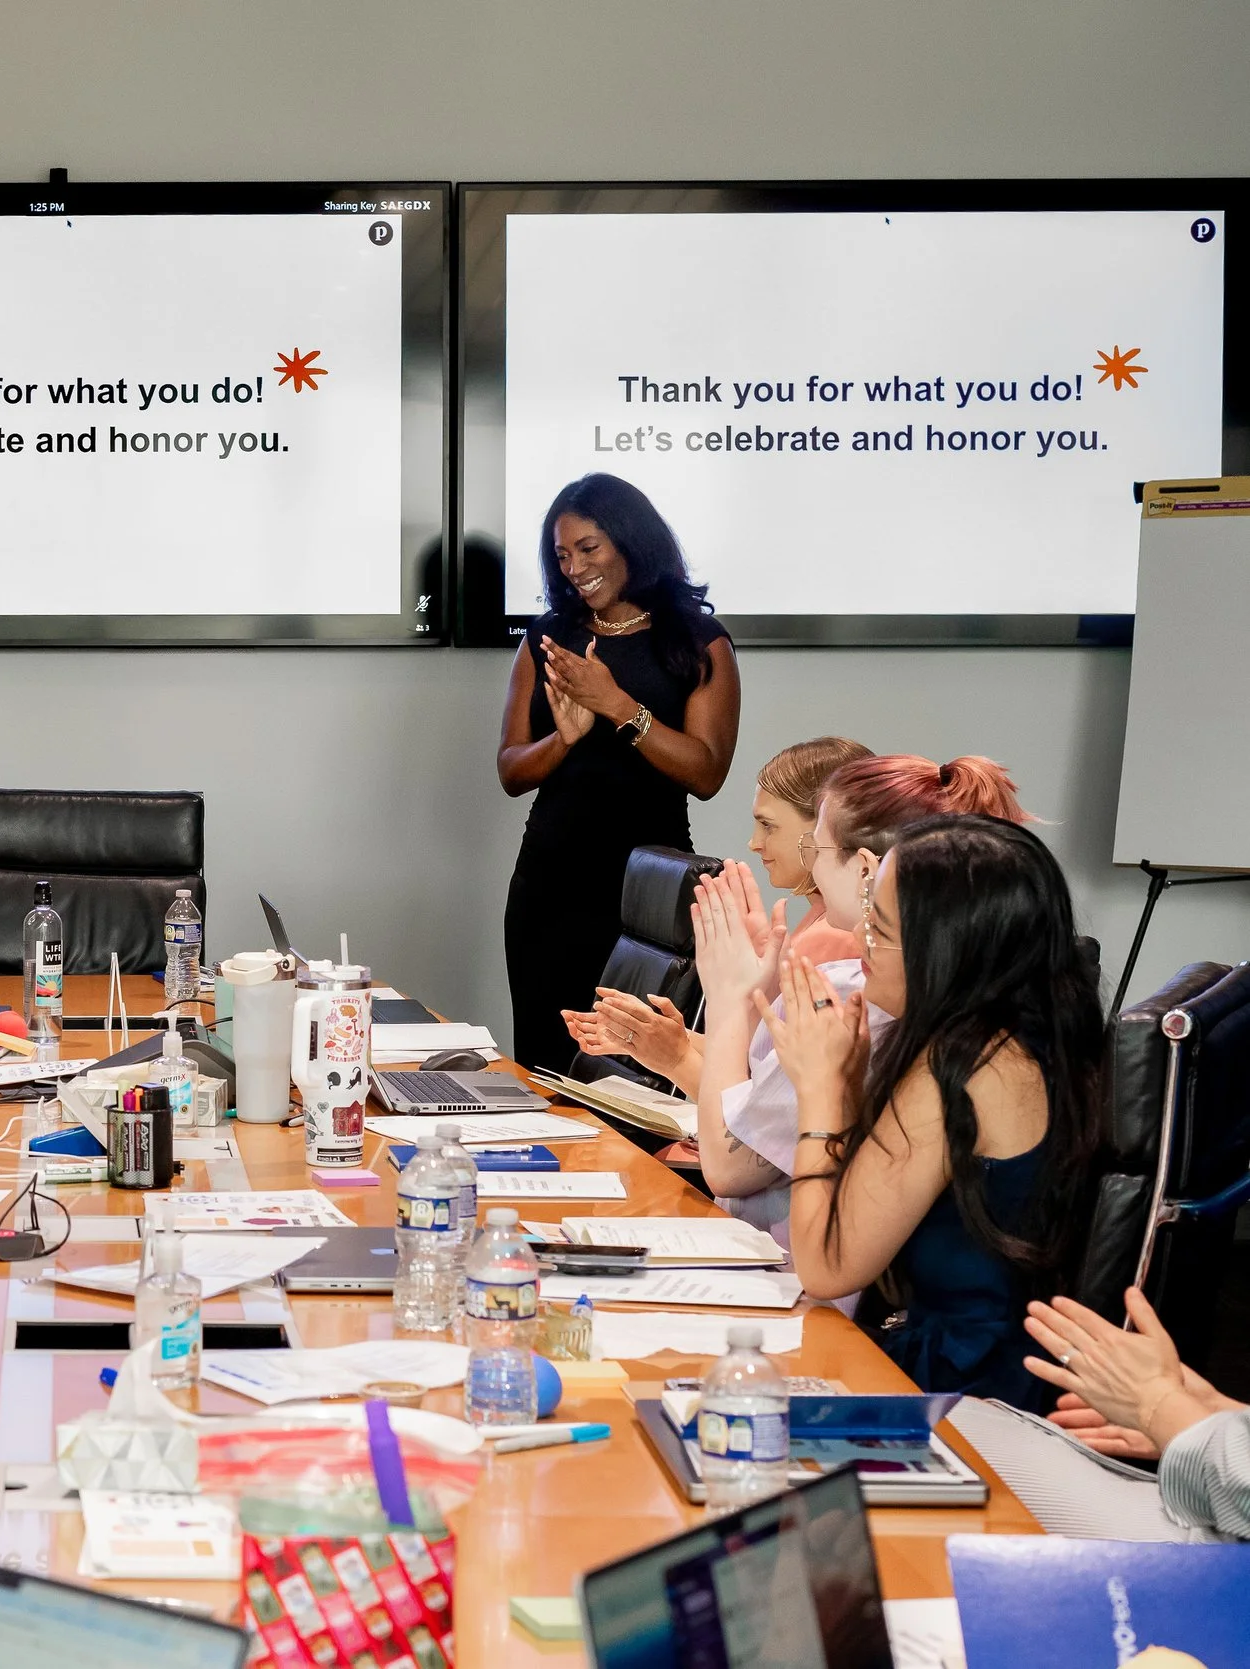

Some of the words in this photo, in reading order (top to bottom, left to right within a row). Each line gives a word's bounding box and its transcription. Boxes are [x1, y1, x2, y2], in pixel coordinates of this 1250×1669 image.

[29, 202, 48, 213] 1:25
[49, 202, 65, 212] PM
[324, 200, 358, 213] Sharing
[360, 201, 377, 213] Key
[47, 377, 127, 404] what
[138, 384, 198, 410] you
[212, 377, 262, 403] do!
[618, 376, 722, 402] Thank
[733, 383, 794, 409] you
[806, 375, 854, 402] for
[864, 375, 945, 401] what
[956, 382, 1017, 408] you
[1030, 375, 1082, 401] do!
[36, 426, 96, 453] and
[110, 426, 208, 452] honor
[218, 433, 289, 460] you.
[595, 426, 672, 451] Let’s
[686, 425, 840, 451] celebrate
[852, 424, 913, 451] and
[927, 424, 1026, 451] honor
[1036, 432, 1108, 458] you.
